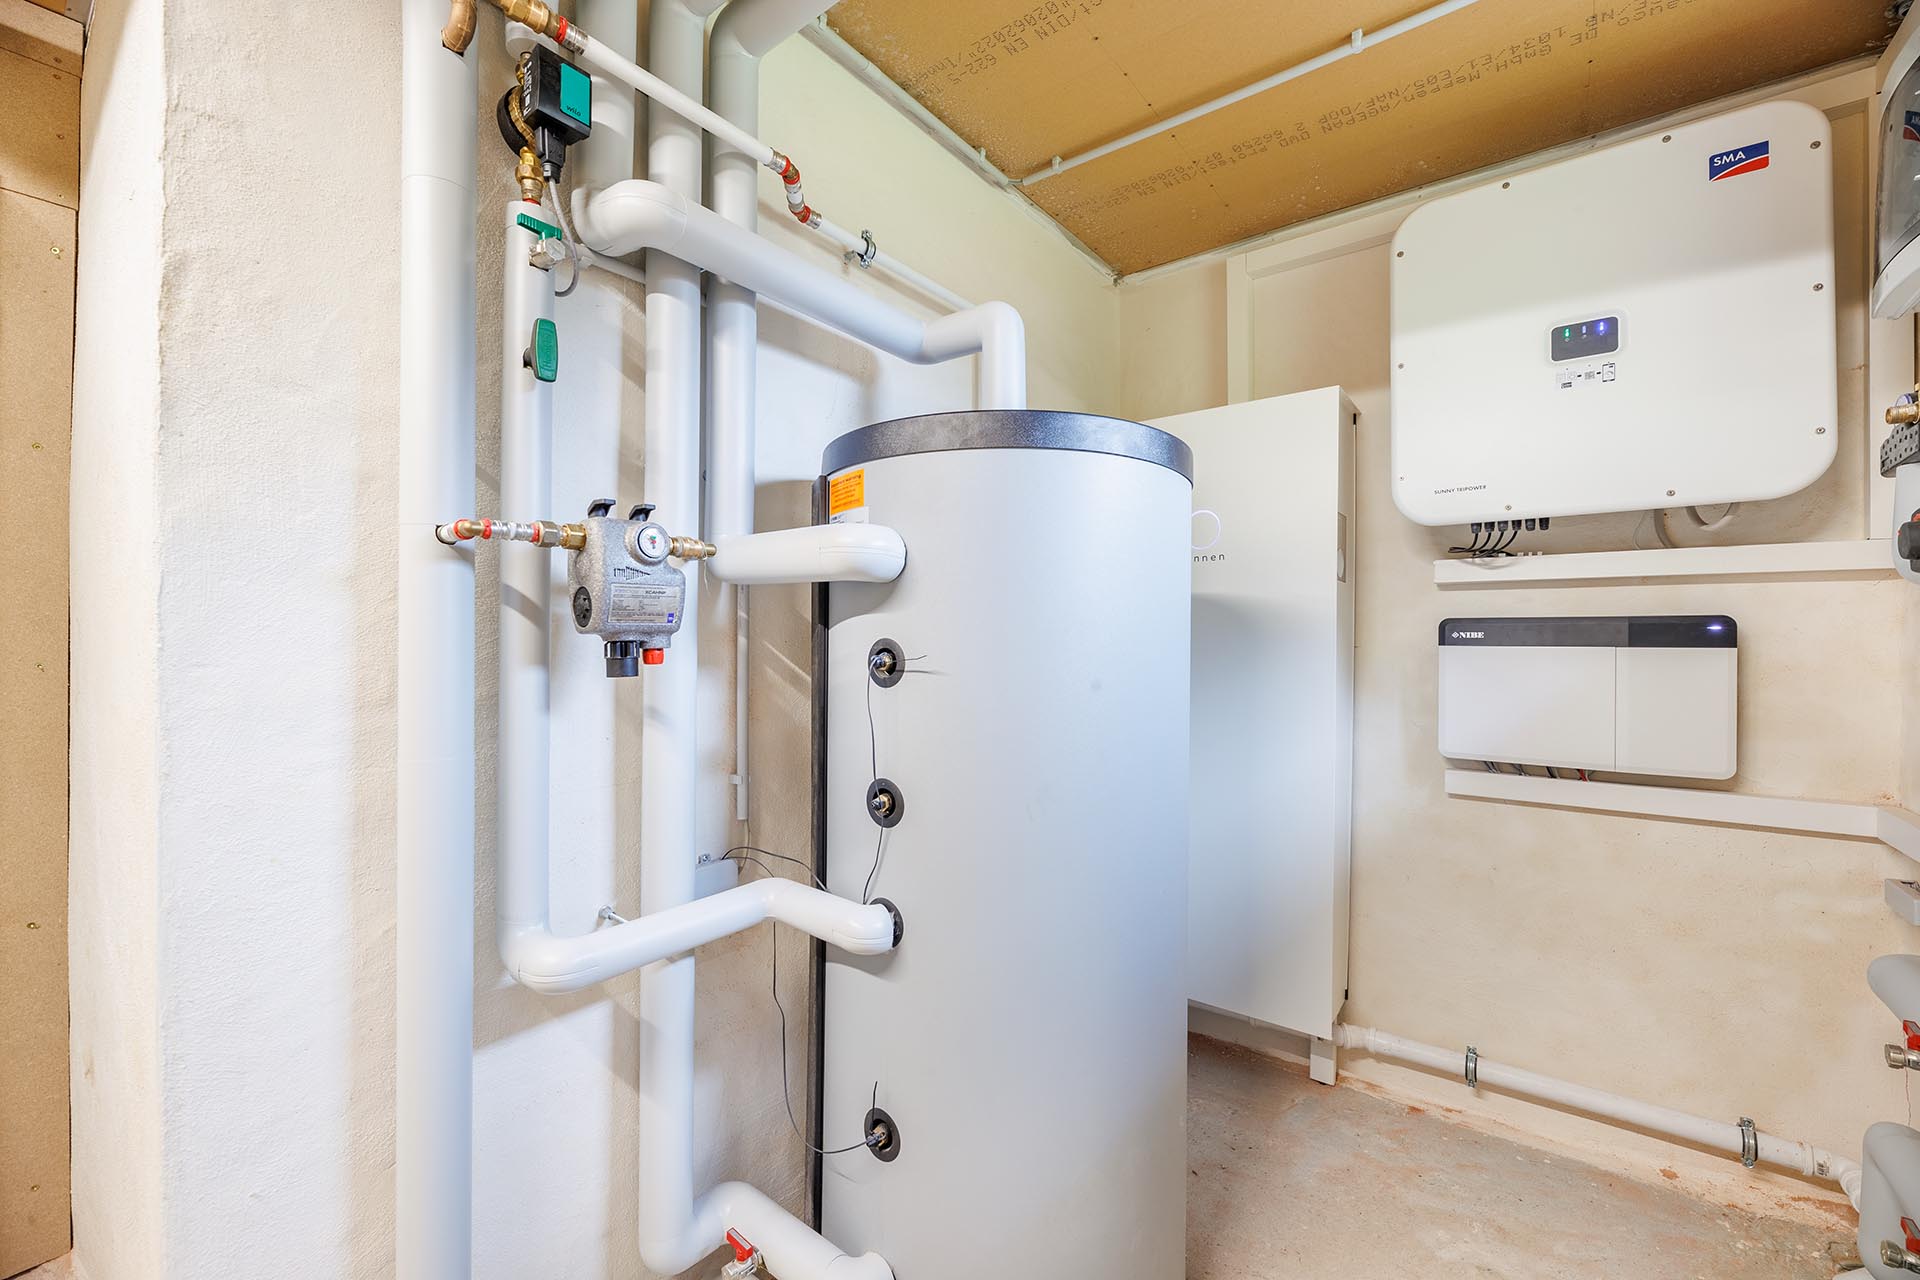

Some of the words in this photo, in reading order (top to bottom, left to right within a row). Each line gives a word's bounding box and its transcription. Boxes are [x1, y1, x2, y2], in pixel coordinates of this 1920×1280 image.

[1003, 37, 1029, 56] EN
[566, 105, 580, 116] wilo
[1713, 151, 1745, 165] SMA
[1434, 487, 1455, 495] SUNNY
